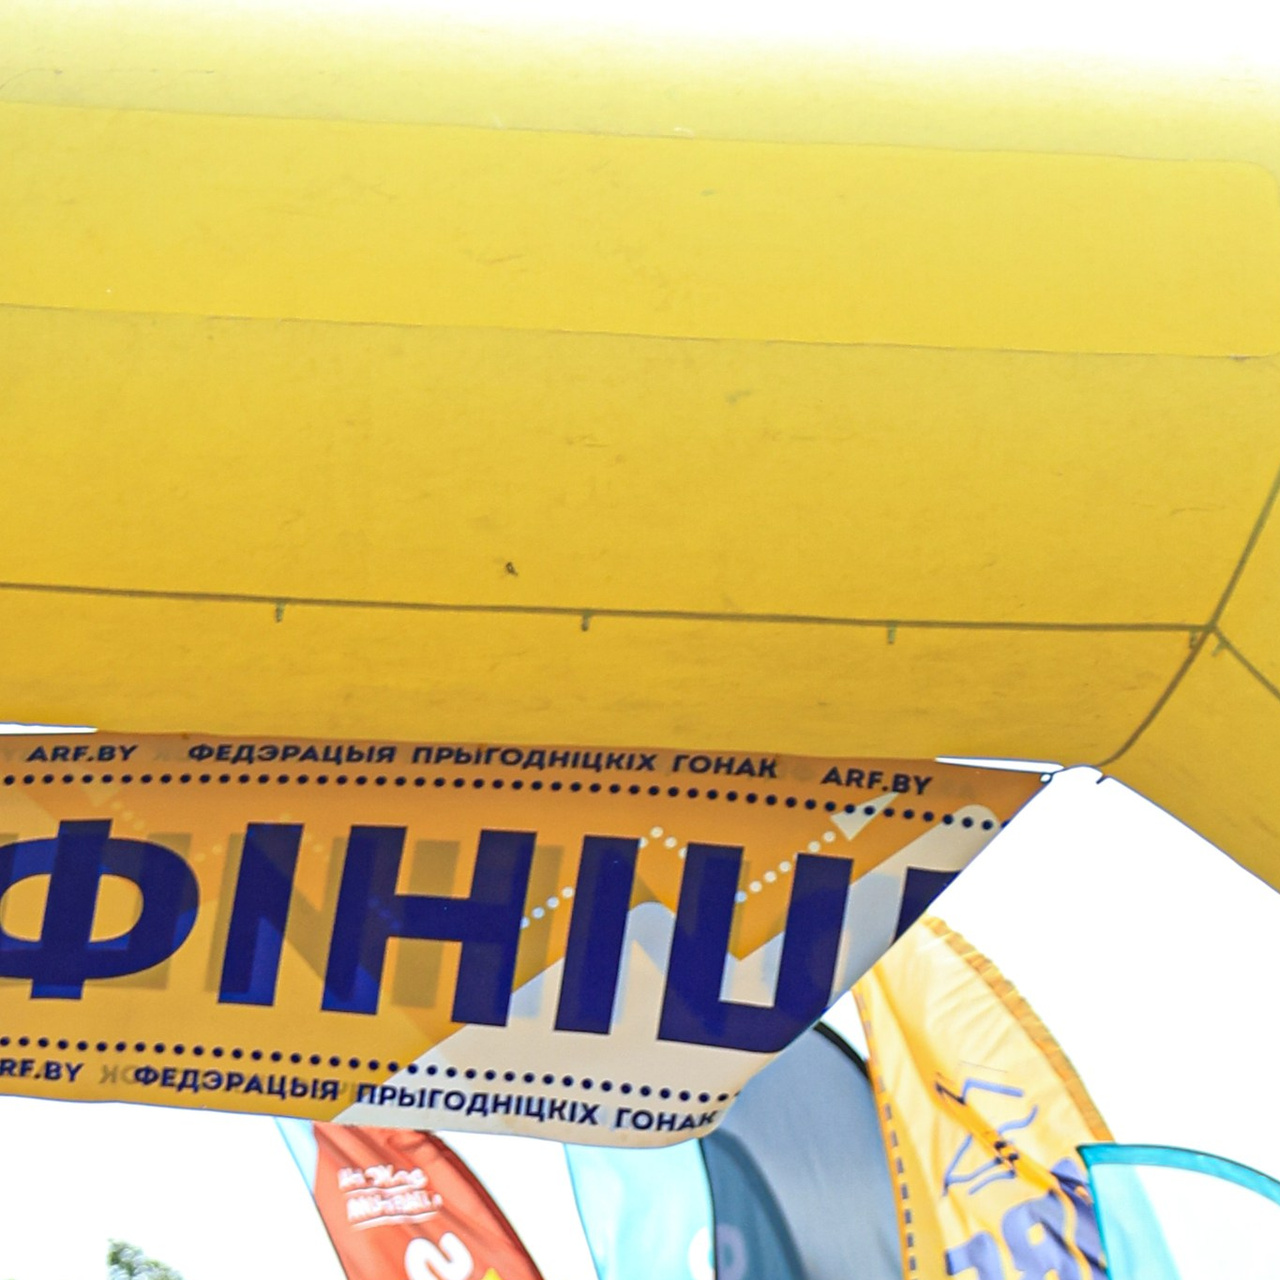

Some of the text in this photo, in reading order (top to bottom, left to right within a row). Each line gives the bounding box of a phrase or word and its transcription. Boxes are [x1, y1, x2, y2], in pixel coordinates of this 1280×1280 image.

[26, 744, 138, 762] ARF.BY
[188, 744, 778, 779] ФЕДЭРАЦЫЯ ПРЫГОДНІЦКІХ ГОНАК
[821, 766, 933, 795] ARF.BY
[0, 1058, 83, 1082] RF.BY
[134, 1065, 718, 1131] ФЕДЭРАЦЫЯ ПРЫГОДНІЦКІХ ГОНАК
